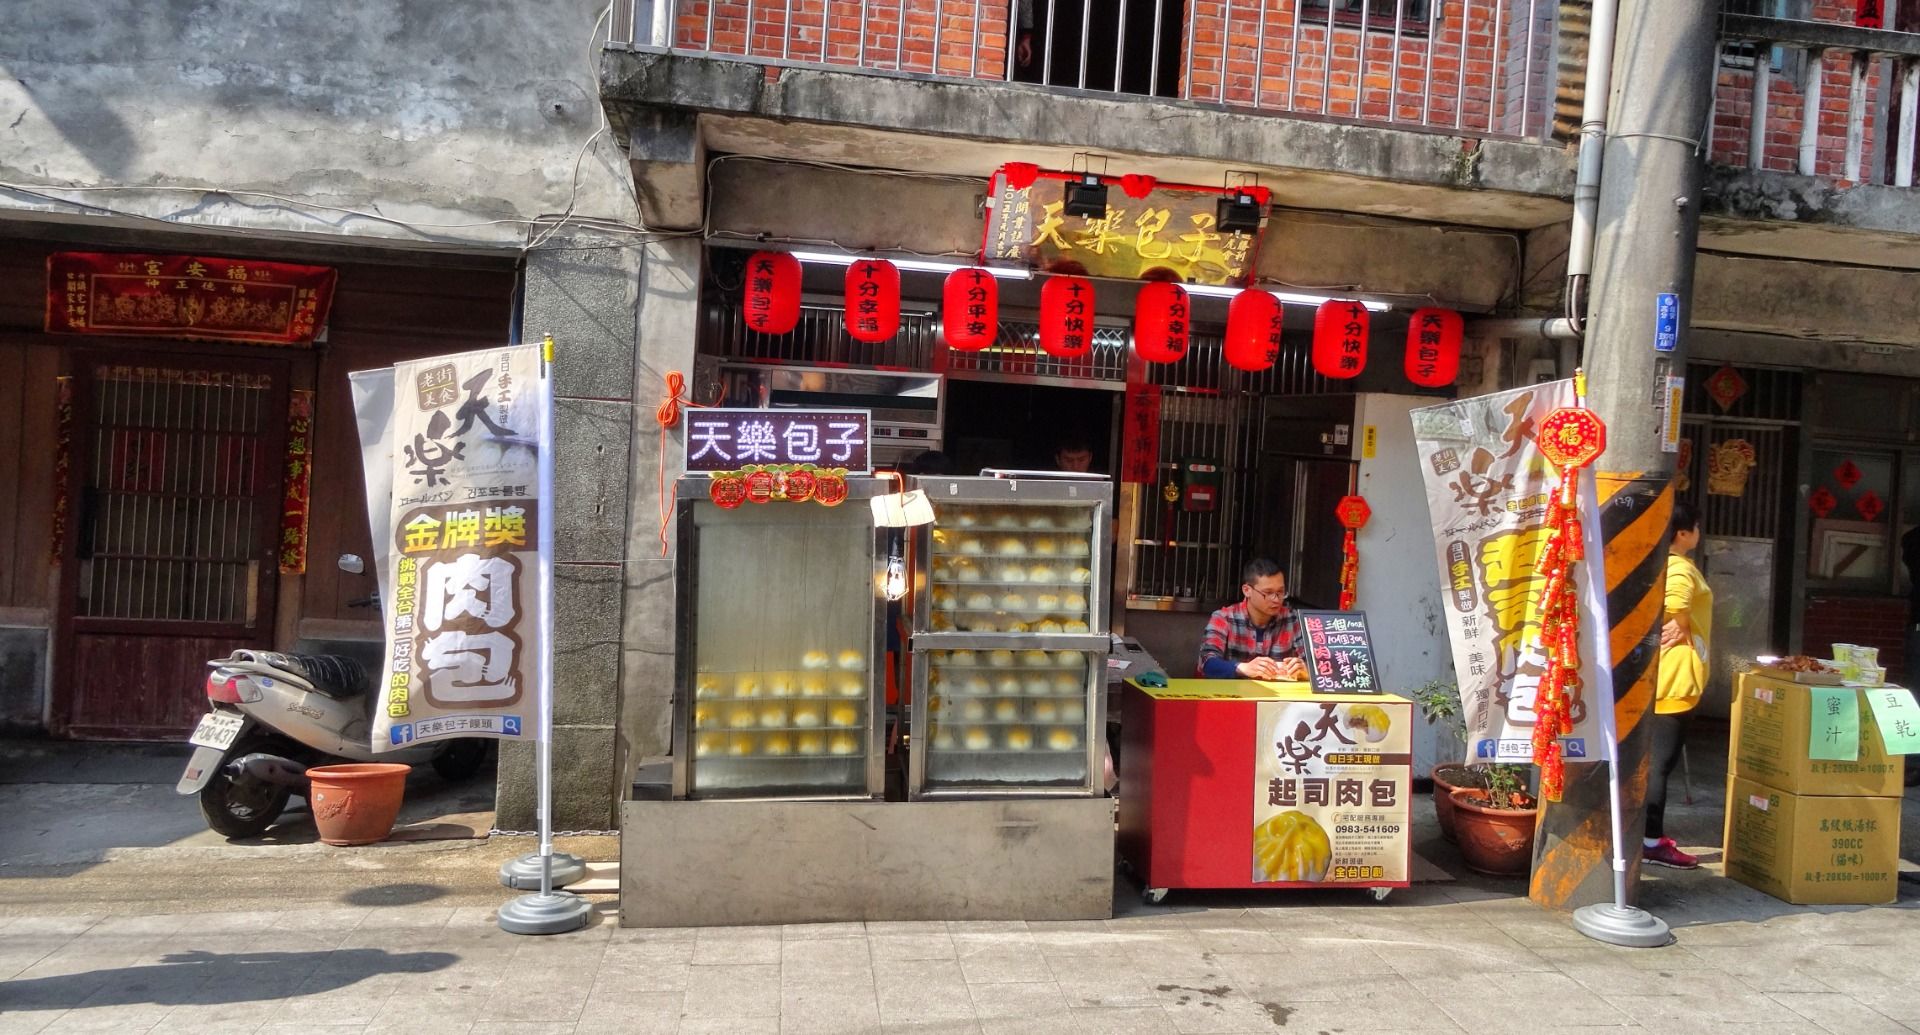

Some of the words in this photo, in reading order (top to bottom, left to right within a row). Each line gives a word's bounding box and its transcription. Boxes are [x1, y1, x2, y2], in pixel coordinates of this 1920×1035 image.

[1030, 200, 1221, 262] 天樂包子
[752, 259, 776, 328] 天樂包子
[858, 265, 880, 333] 十分幸福
[966, 270, 988, 337] 十分平安
[1063, 282, 1086, 350] 十分快樂
[1166, 284, 1186, 353] 十分幸福
[1264, 301, 1283, 364] 十分平安
[1338, 304, 1364, 371] 十分快樂
[1416, 313, 1443, 378] 天樂包子
[419, 368, 453, 388] 老街
[424, 387, 455, 407] 美食
[404, 368, 518, 487] 天樂
[691, 420, 864, 462] 天樂包子
[1558, 422, 1582, 447] 福
[405, 505, 526, 554] 金牌獎
[422, 553, 516, 702] 肉包
[1306, 617, 1333, 675] 起司肉包
[1335, 651, 1354, 679] 新年
[1353, 663, 1371, 688] 快樂
[419, 718, 494, 735] 天樂包子饅頭
[1825, 696, 1843, 745] 蜜汁
[1885, 693, 1917, 738] 豆乾
[1268, 777, 1396, 807] 起司肉包
[1335, 825, 1400, 833] 0983-541609
[1832, 838, 1863, 849] 390CC
